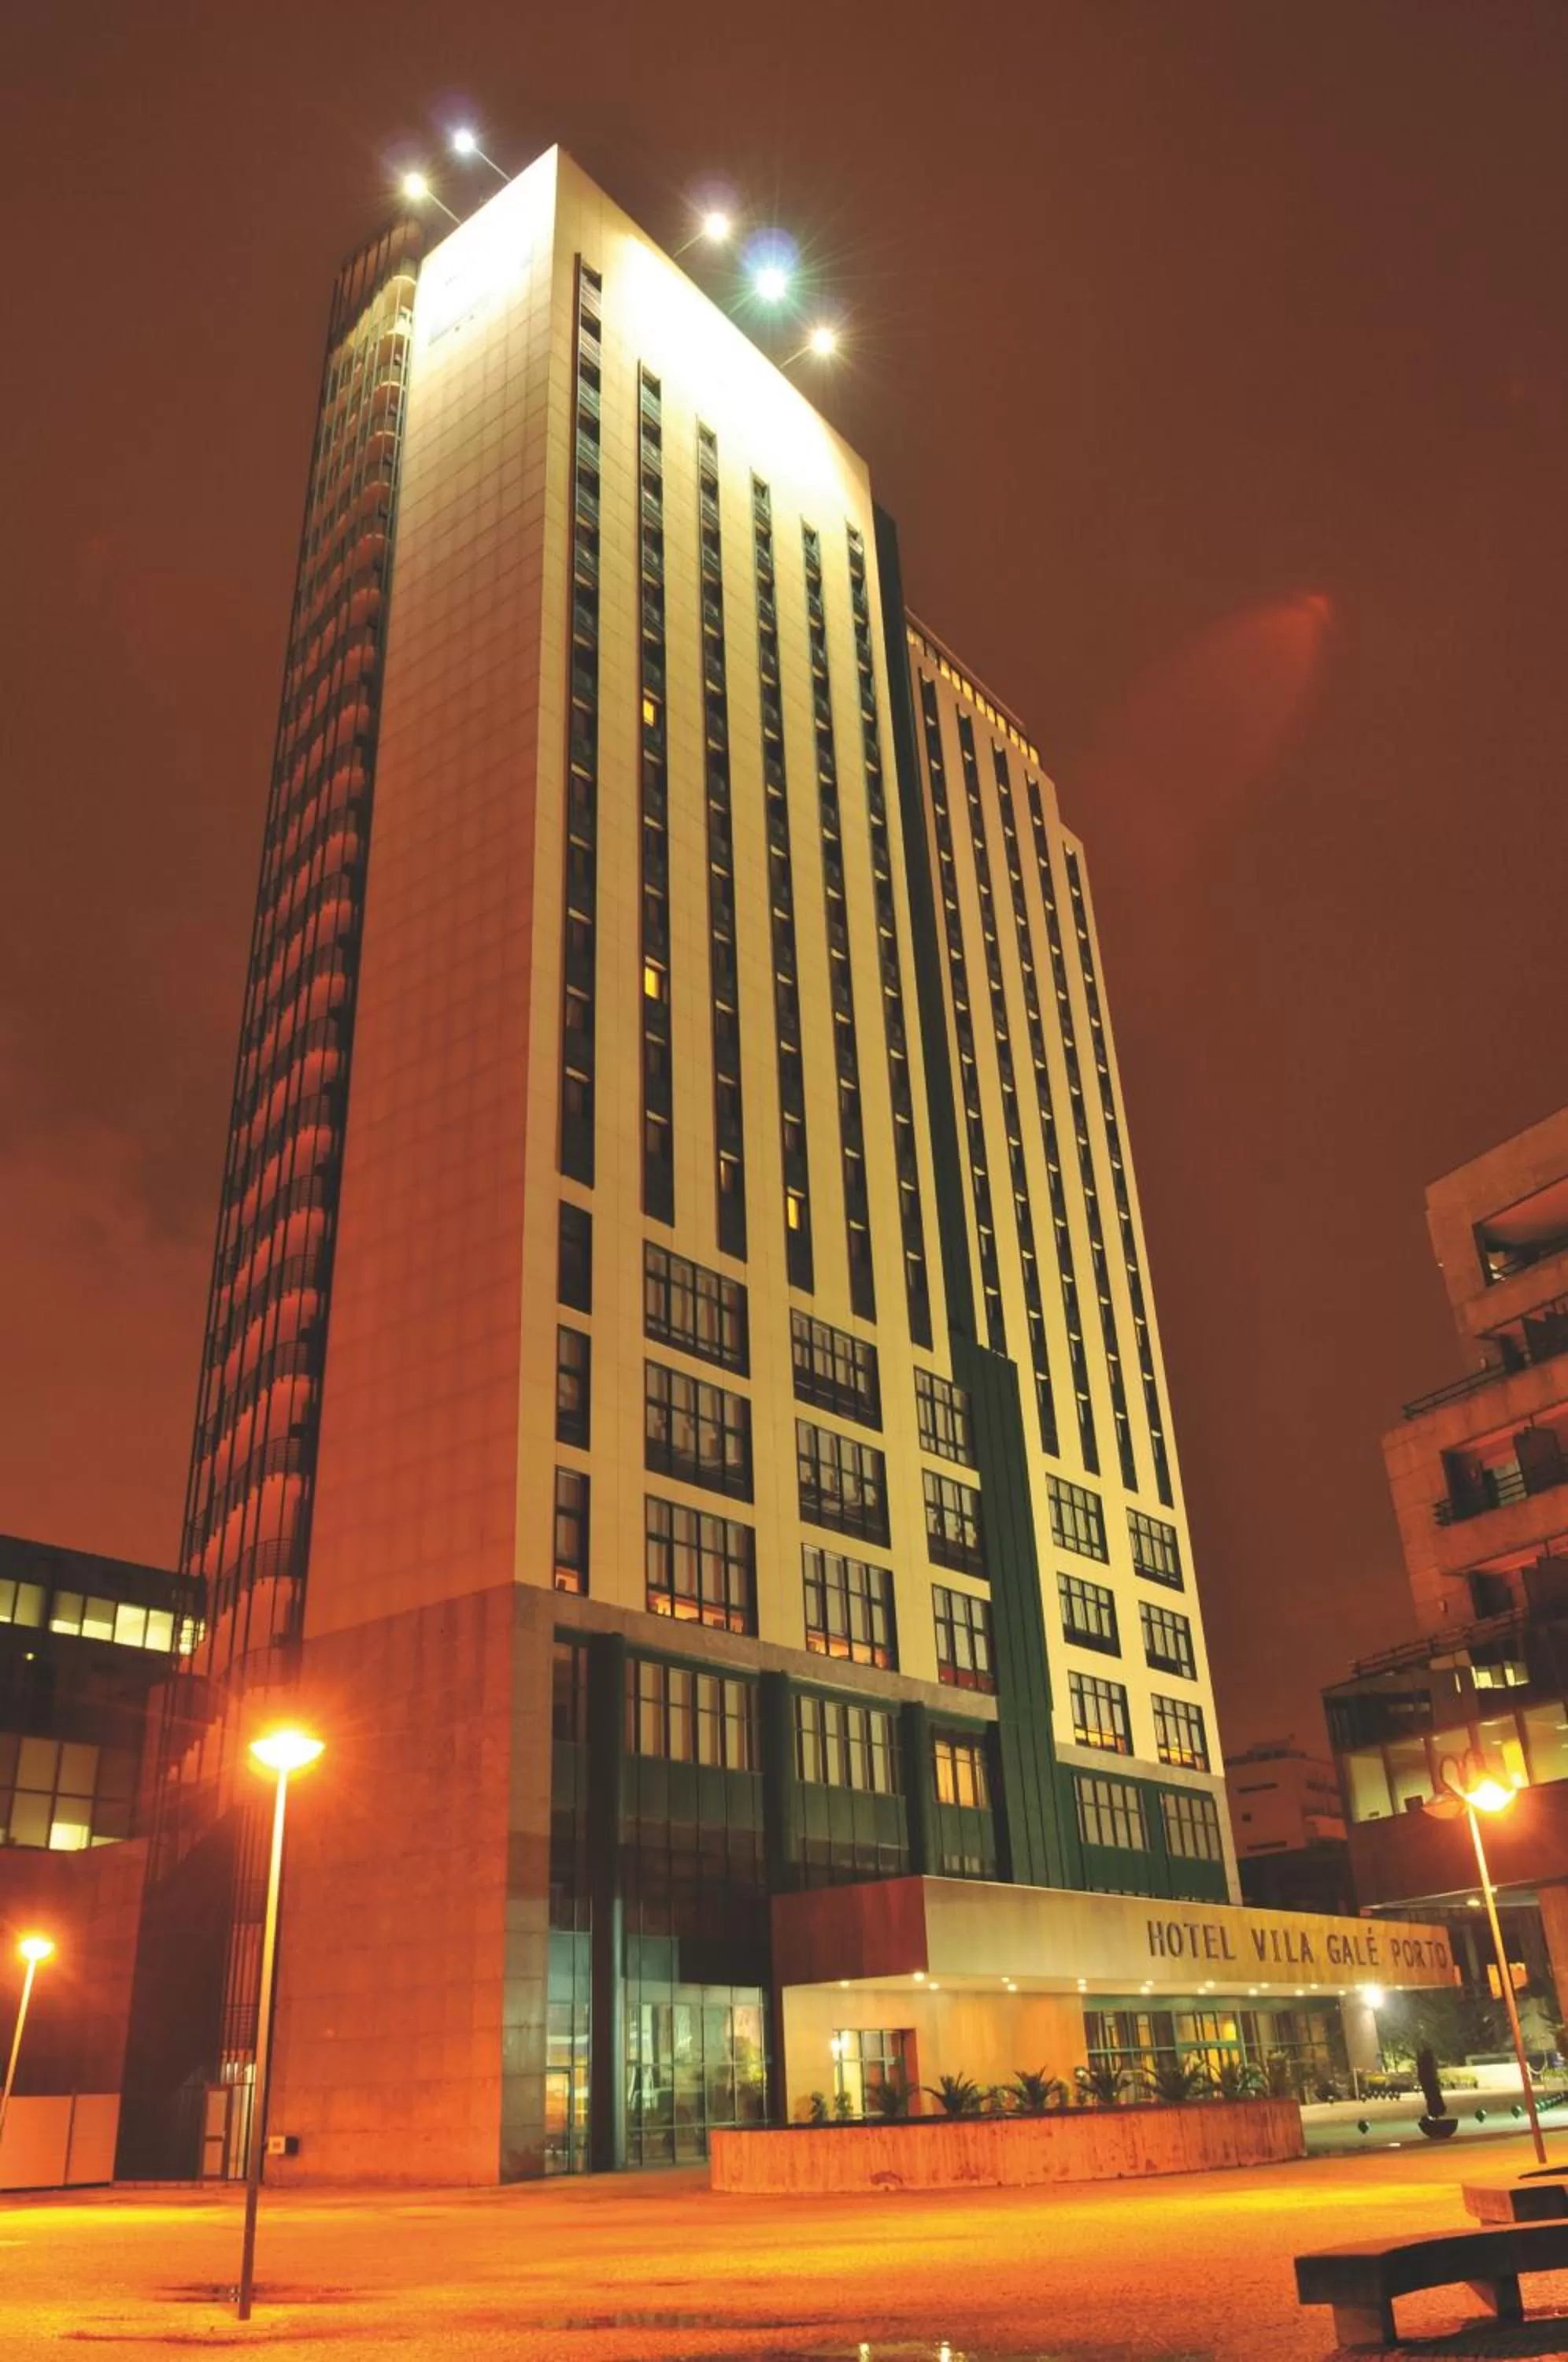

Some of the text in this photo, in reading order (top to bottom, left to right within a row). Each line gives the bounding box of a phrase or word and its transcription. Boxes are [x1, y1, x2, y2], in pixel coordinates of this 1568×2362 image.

[1148, 1920, 1446, 1969] HOTEL VILA GALÉ PORTO
